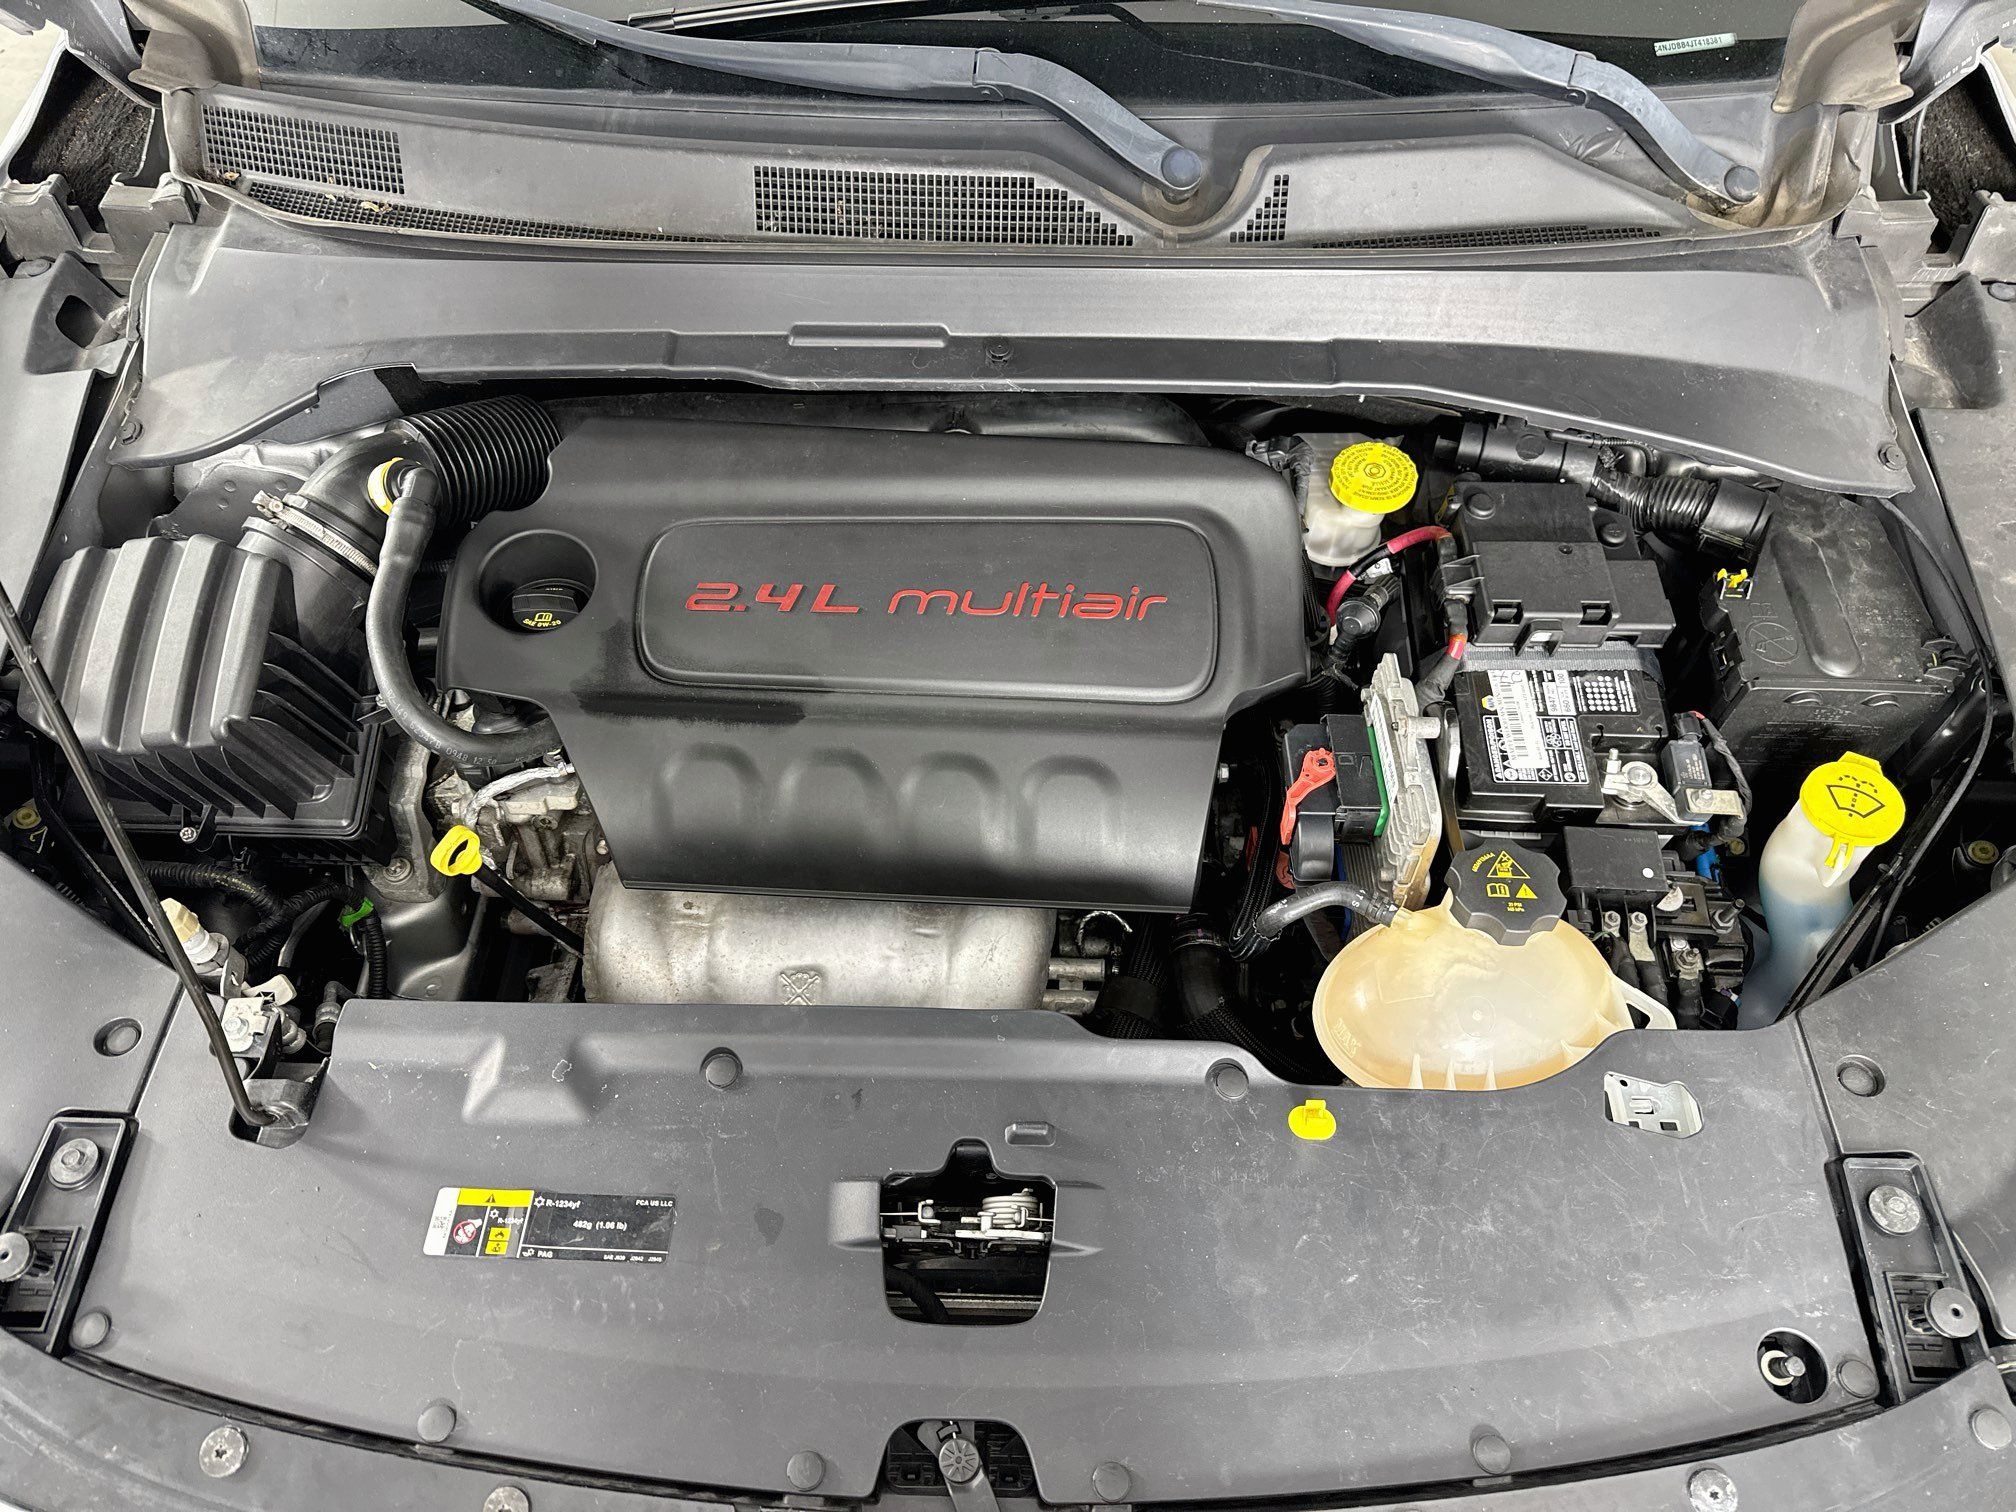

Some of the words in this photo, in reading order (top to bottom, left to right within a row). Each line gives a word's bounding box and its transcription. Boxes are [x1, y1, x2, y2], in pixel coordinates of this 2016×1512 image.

[887, 581, 1168, 619] multiair
[522, 618, 537, 627] SAE
[536, 619, 562, 628] 0W-20
[1548, 695, 1558, 712] 9847
[546, 1199, 581, 1210] R-1234yf
[616, 1221, 628, 1232] lb)
[537, 1250, 554, 1259] PAG
